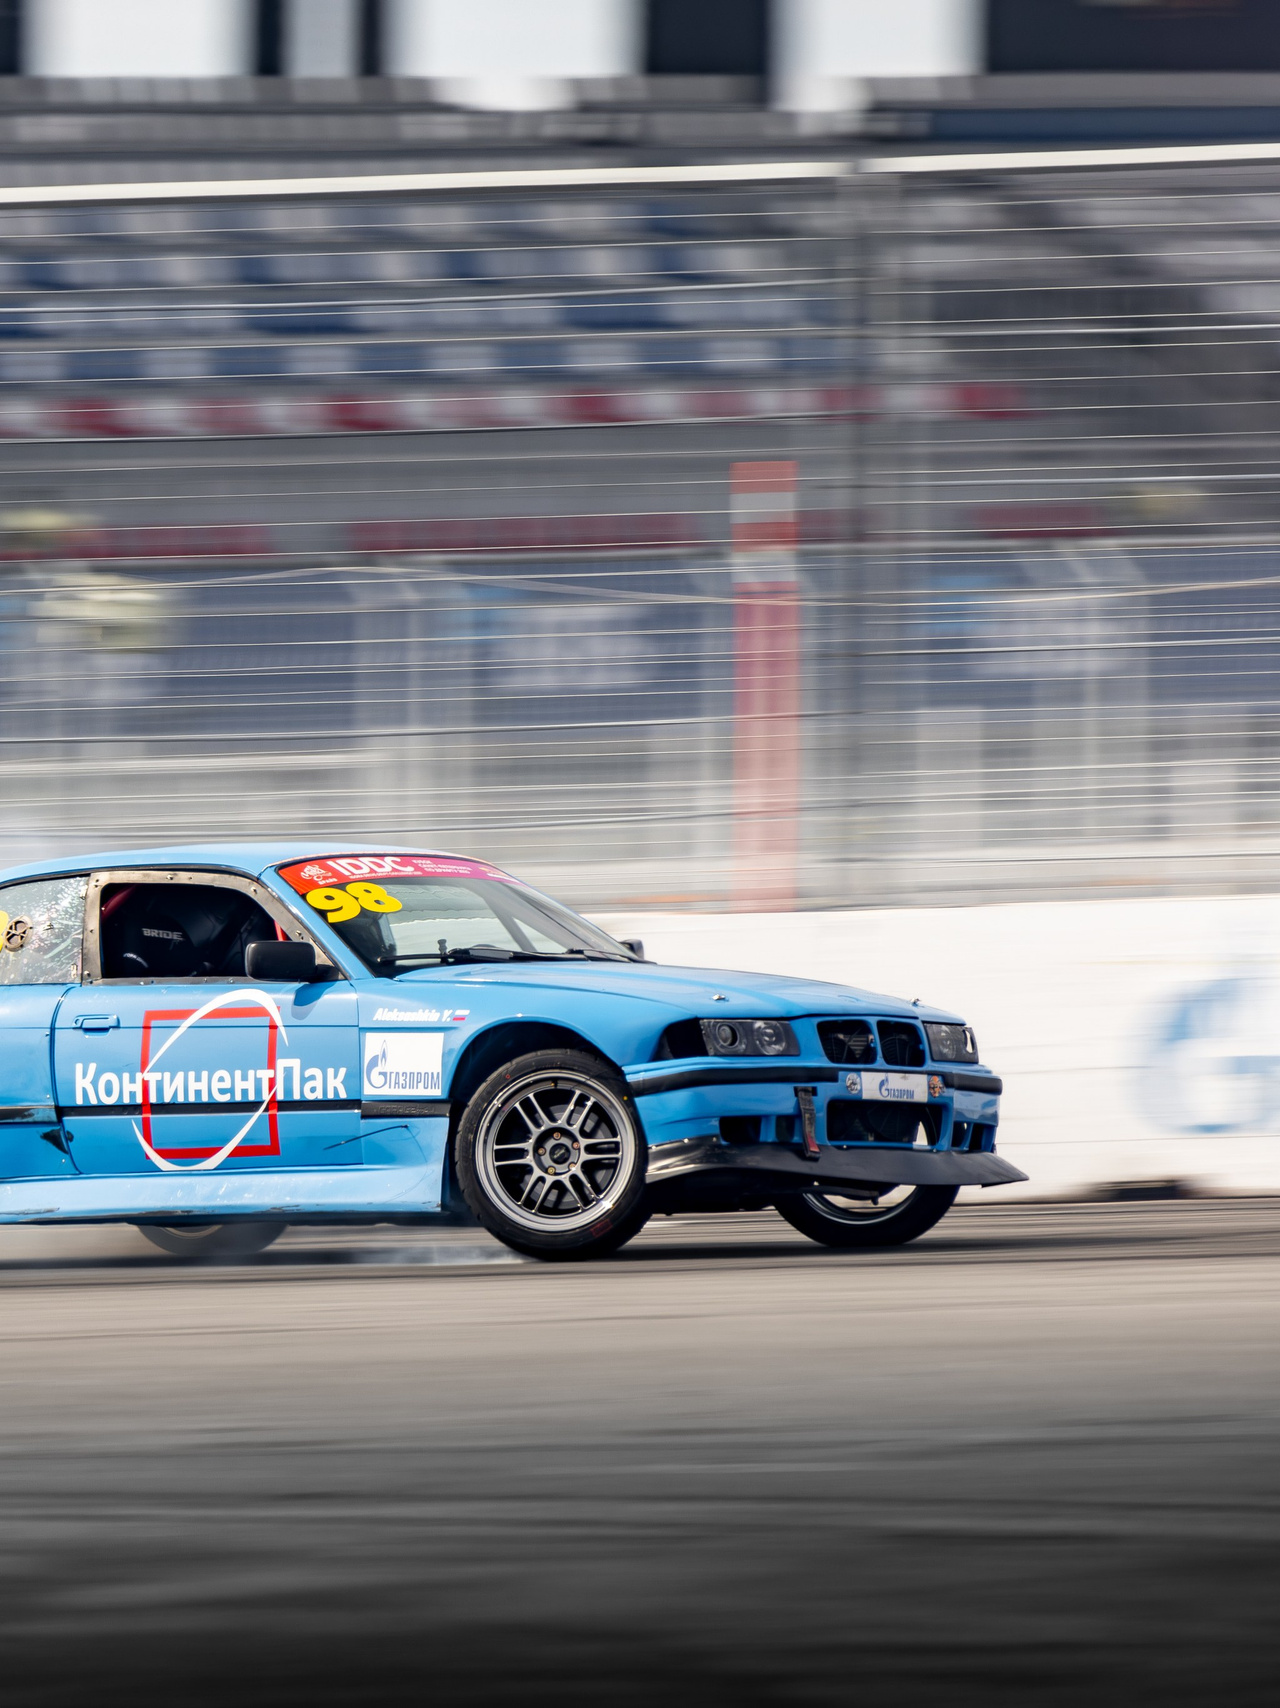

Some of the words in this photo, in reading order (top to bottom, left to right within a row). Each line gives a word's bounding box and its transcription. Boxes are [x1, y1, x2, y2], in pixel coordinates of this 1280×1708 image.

[326, 856, 415, 876] IDDC
[306, 881, 403, 924] 98
[142, 928, 185, 941] BRIDE
[75, 1058, 347, 1105] КонтинентПак
[388, 1071, 440, 1090] ГАЗПРОМ
[889, 1088, 915, 1100] ГАЗПРОМ
